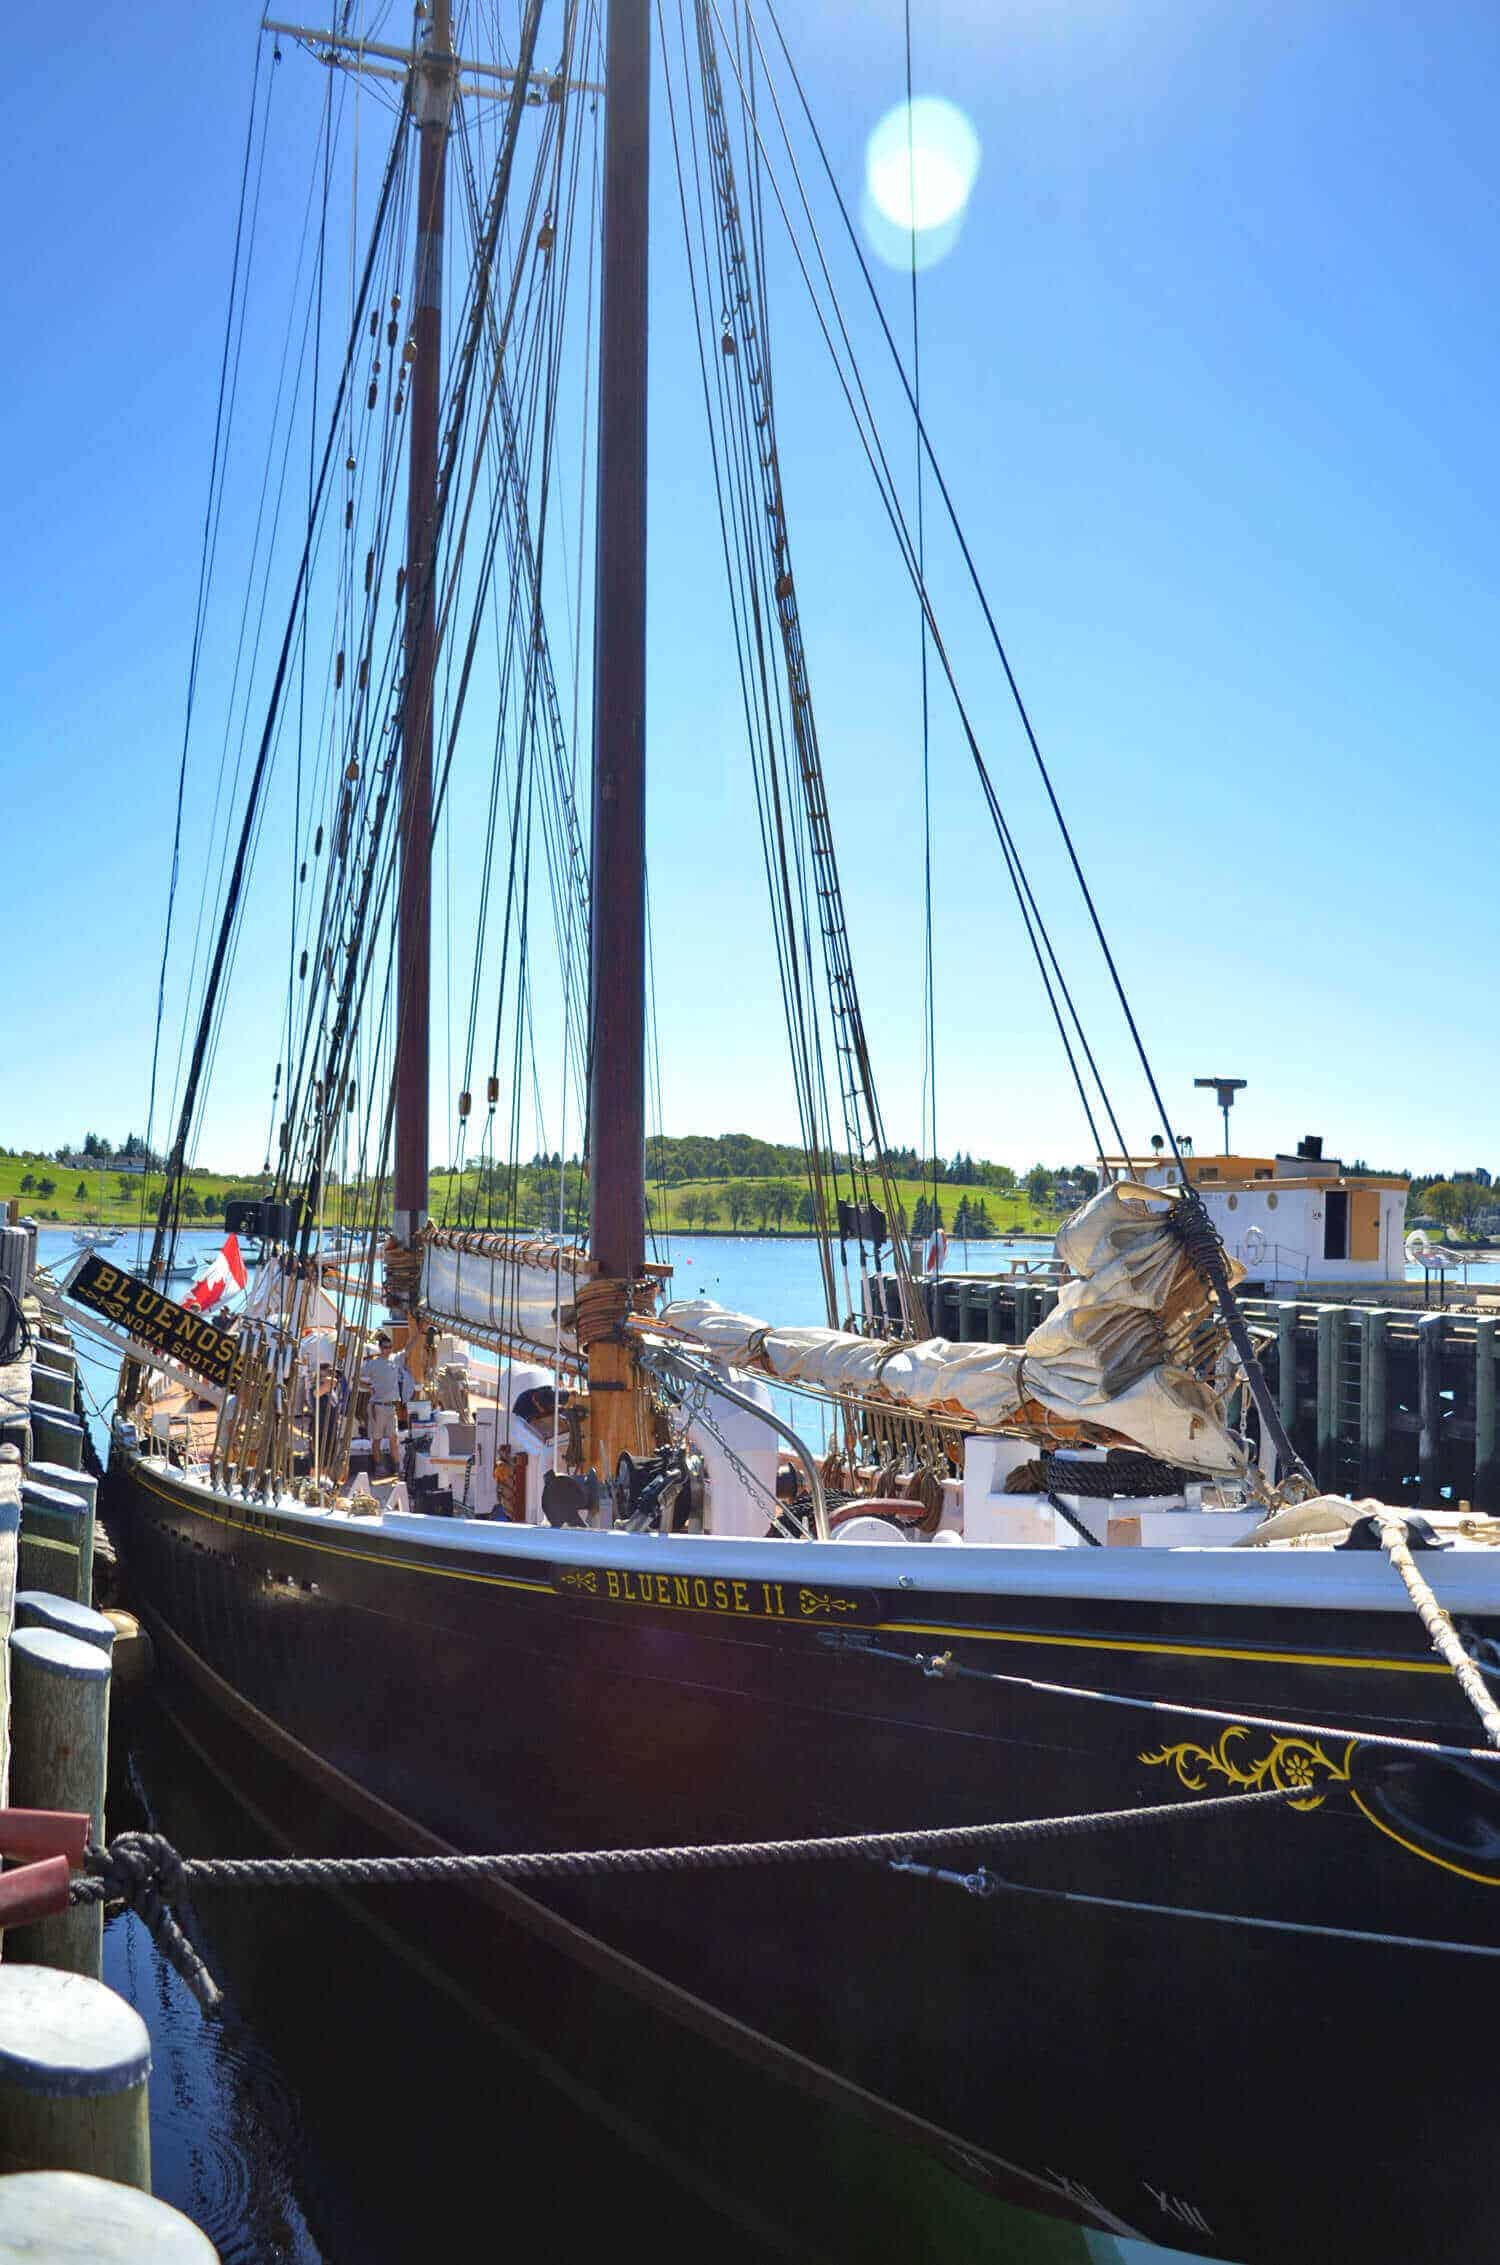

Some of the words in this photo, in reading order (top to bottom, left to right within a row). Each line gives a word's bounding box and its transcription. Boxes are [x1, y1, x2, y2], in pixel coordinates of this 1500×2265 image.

[123, 1311, 165, 1345] NOVA
[172, 1340, 226, 1380] SCOTIA
[605, 1570, 750, 1611] BLUENOSE
[762, 1583, 785, 1615] II
